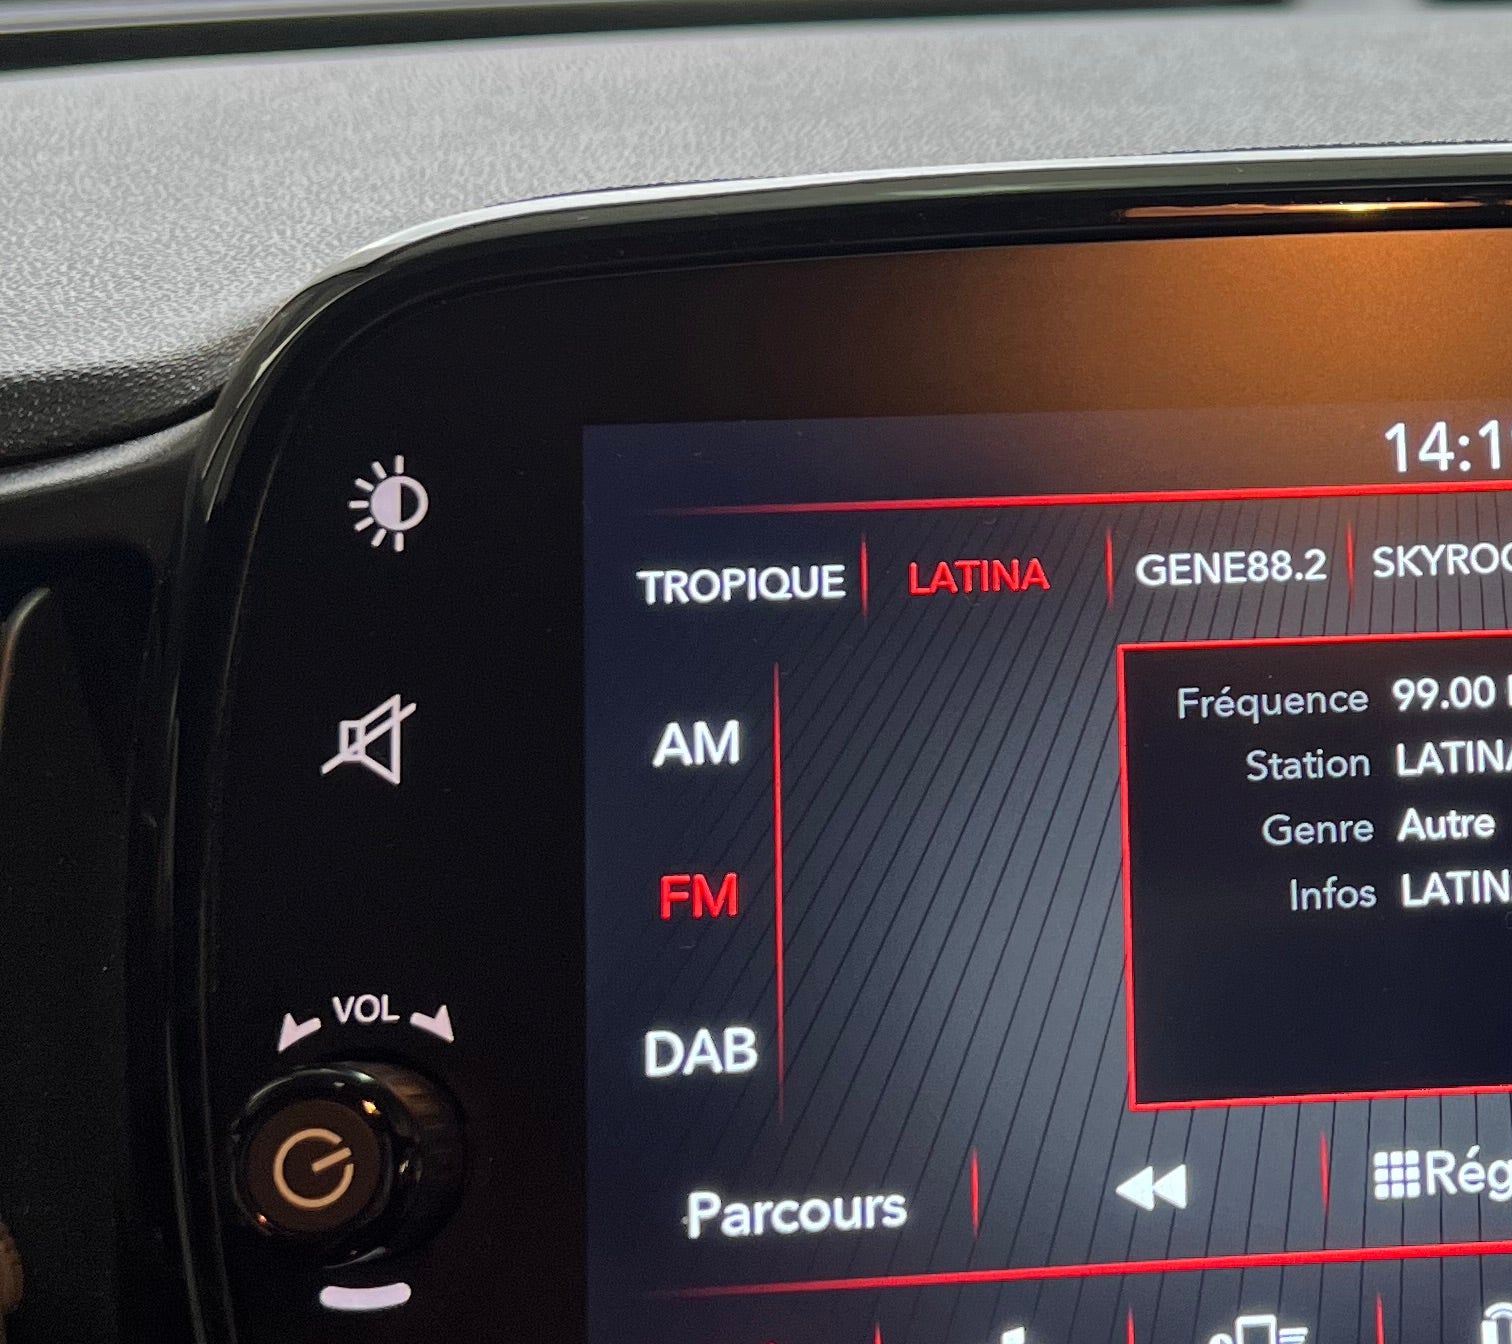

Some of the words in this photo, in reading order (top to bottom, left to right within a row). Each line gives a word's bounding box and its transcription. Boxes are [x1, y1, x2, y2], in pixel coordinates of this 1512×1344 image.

[634, 563, 847, 606] TROPIQUE
[908, 557, 1052, 596] LATINA
[1135, 547, 1328, 587] GENE88.2
[1177, 685, 1370, 725] Fréquence
[1391, 674, 1497, 712] 99.00
[651, 718, 741, 768] AM
[1245, 747, 1371, 782] Station
[1261, 812, 1375, 847] Genre
[1396, 806, 1497, 843] Autre
[660, 871, 738, 920] FM
[1289, 874, 1378, 912] Infos
[331, 993, 402, 1024] VOL
[644, 1025, 759, 1078] DAB
[687, 1190, 909, 1240] Parcours
